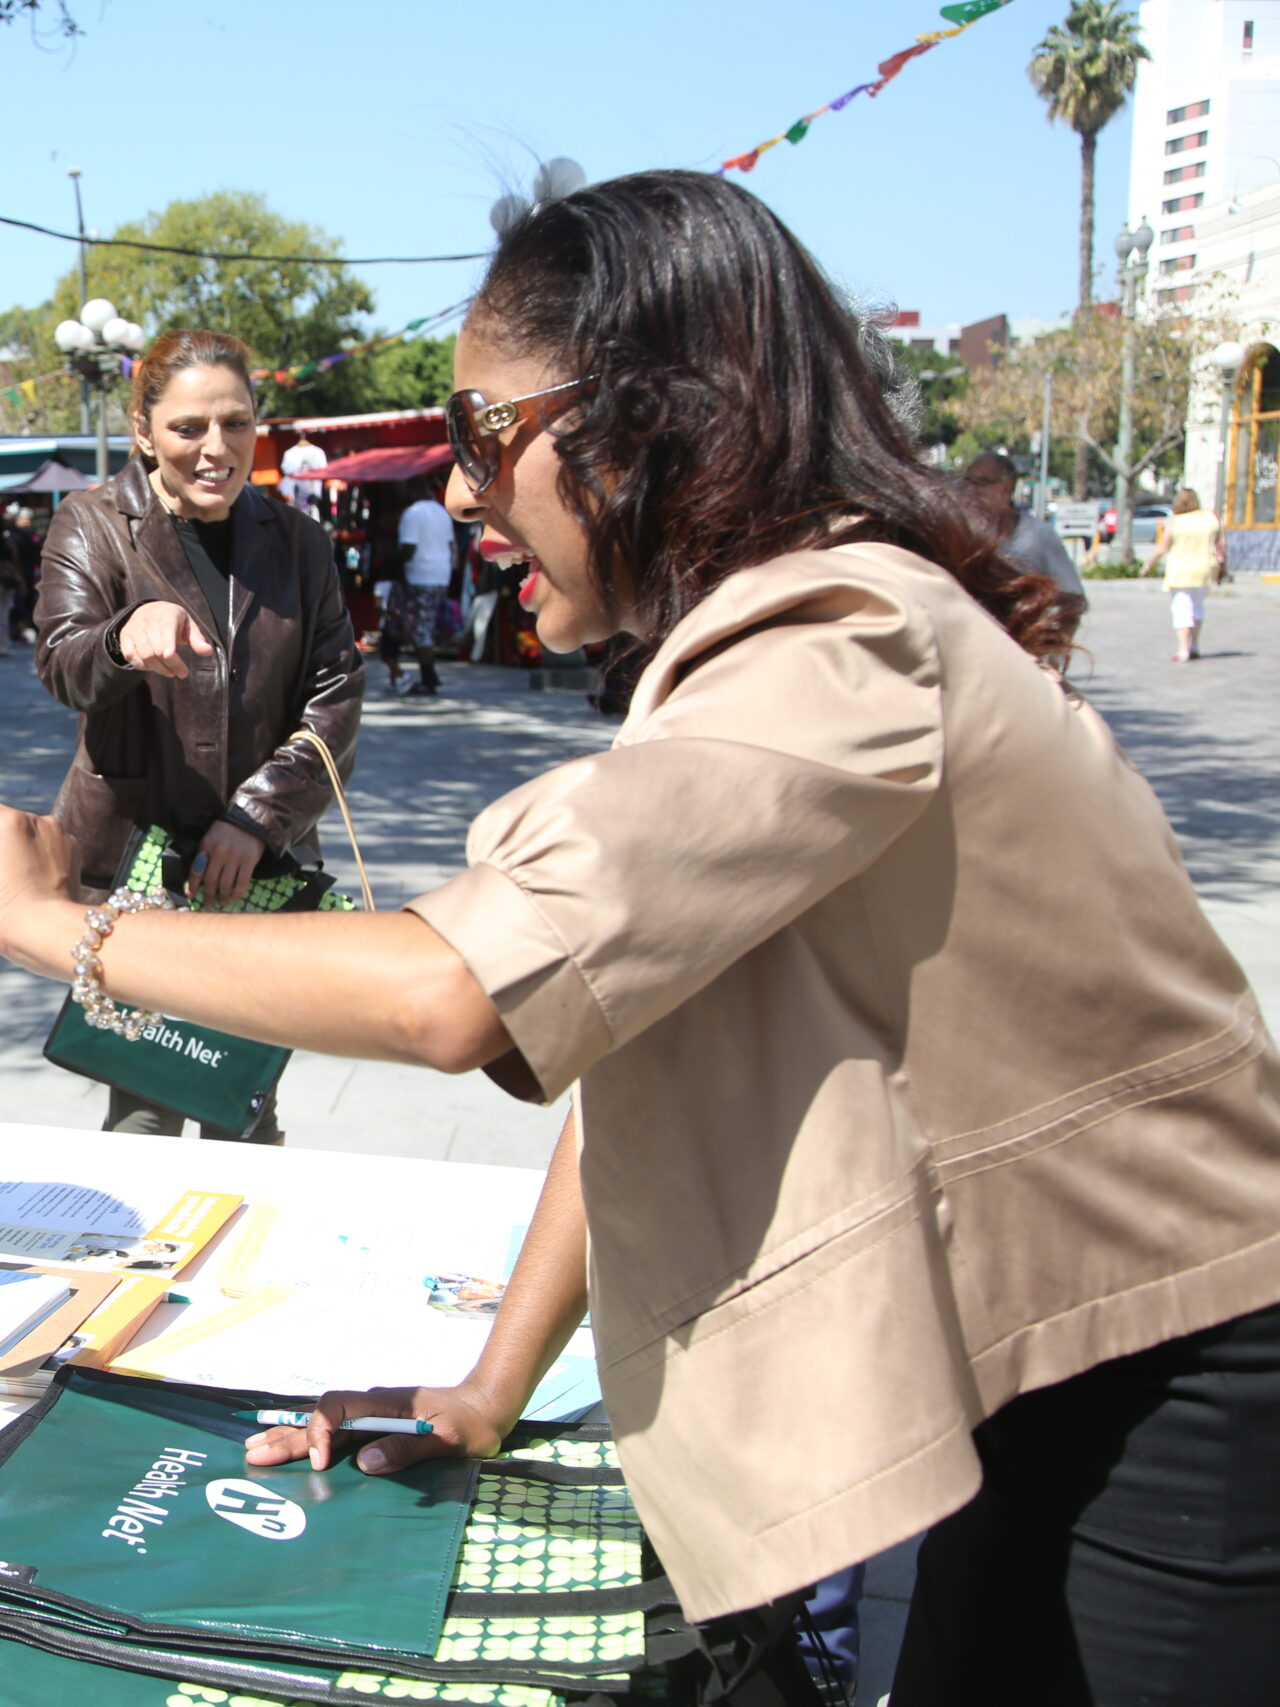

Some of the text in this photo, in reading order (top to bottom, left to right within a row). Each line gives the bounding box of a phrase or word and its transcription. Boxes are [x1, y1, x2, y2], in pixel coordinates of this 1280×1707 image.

[183, 1036, 223, 1069] Net
[101, 1447, 208, 1546] Health Net
